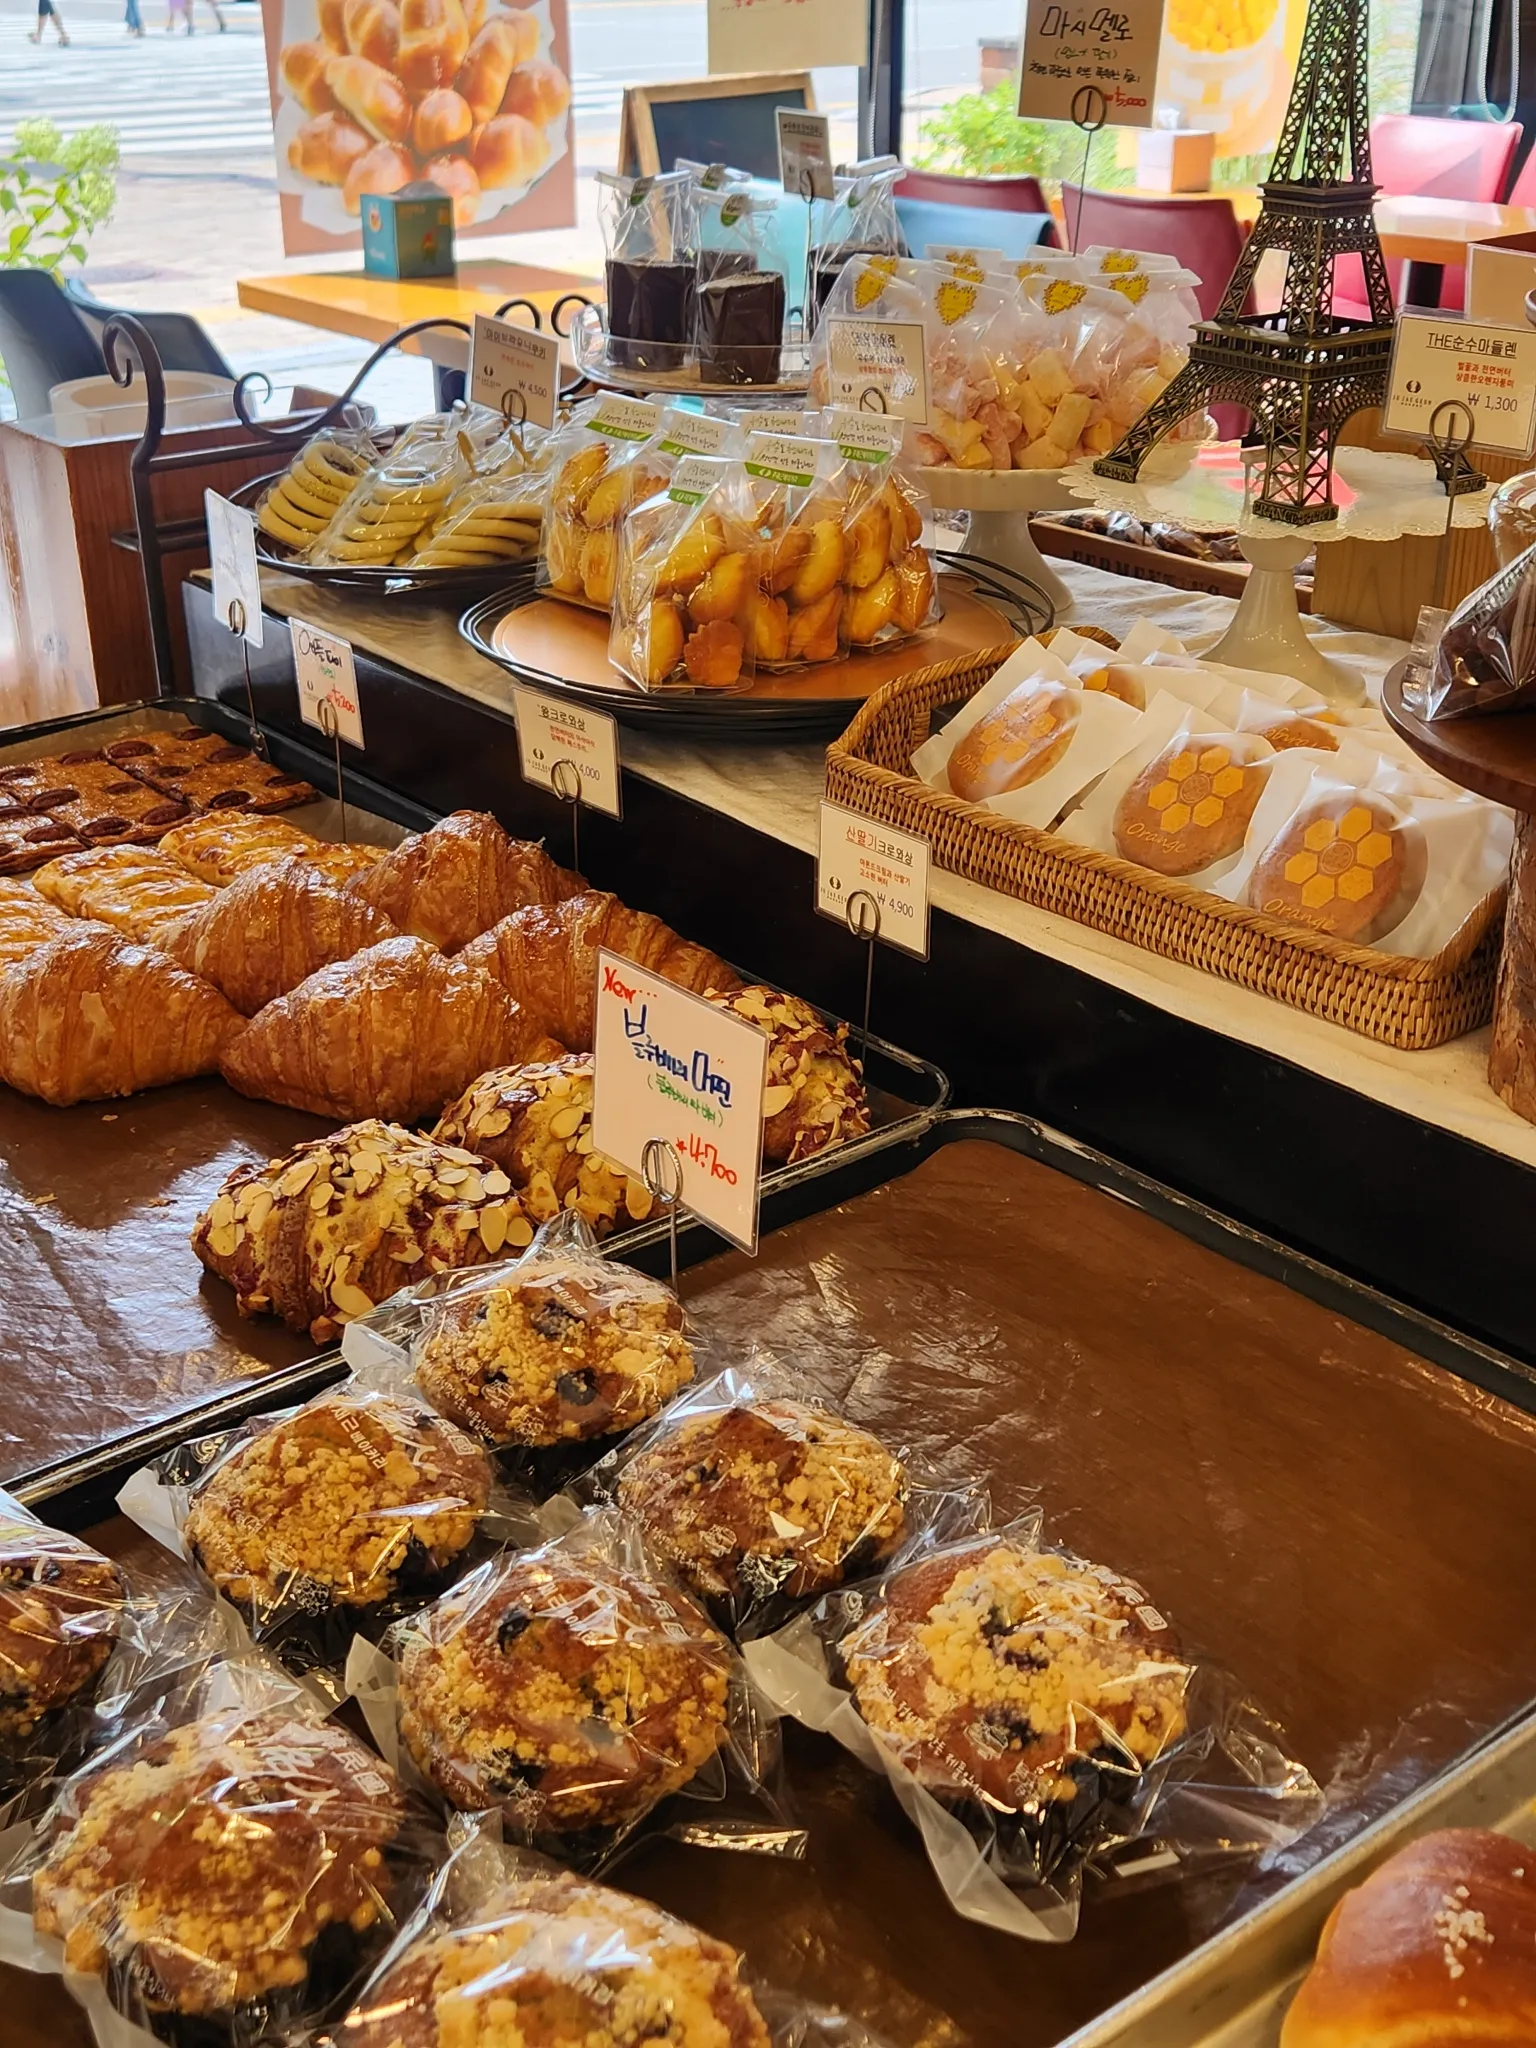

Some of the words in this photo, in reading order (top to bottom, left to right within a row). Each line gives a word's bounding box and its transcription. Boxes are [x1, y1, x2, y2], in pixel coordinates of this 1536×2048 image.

[1040, 6, 1133, 42] 마시멜로
[1428, 333, 1517, 357] THE순수마들렌
[1456, 373, 1514, 388] 상큼한오렌지풍미
[1482, 365, 1511, 377] 천연버터
[1485, 396, 1518, 412] 1,300
[579, 764, 600, 780] 4,000
[846, 826, 914, 867] 산딸기크로와상
[1127, 823, 1186, 854] Orange
[860, 858, 892, 878] 아몬드크림과
[894, 872, 911, 887] 산딸기
[888, 898, 914, 918] 4,900
[1263, 899, 1337, 931] Orange
[330, 1405, 389, 1470] 재근베이커리
